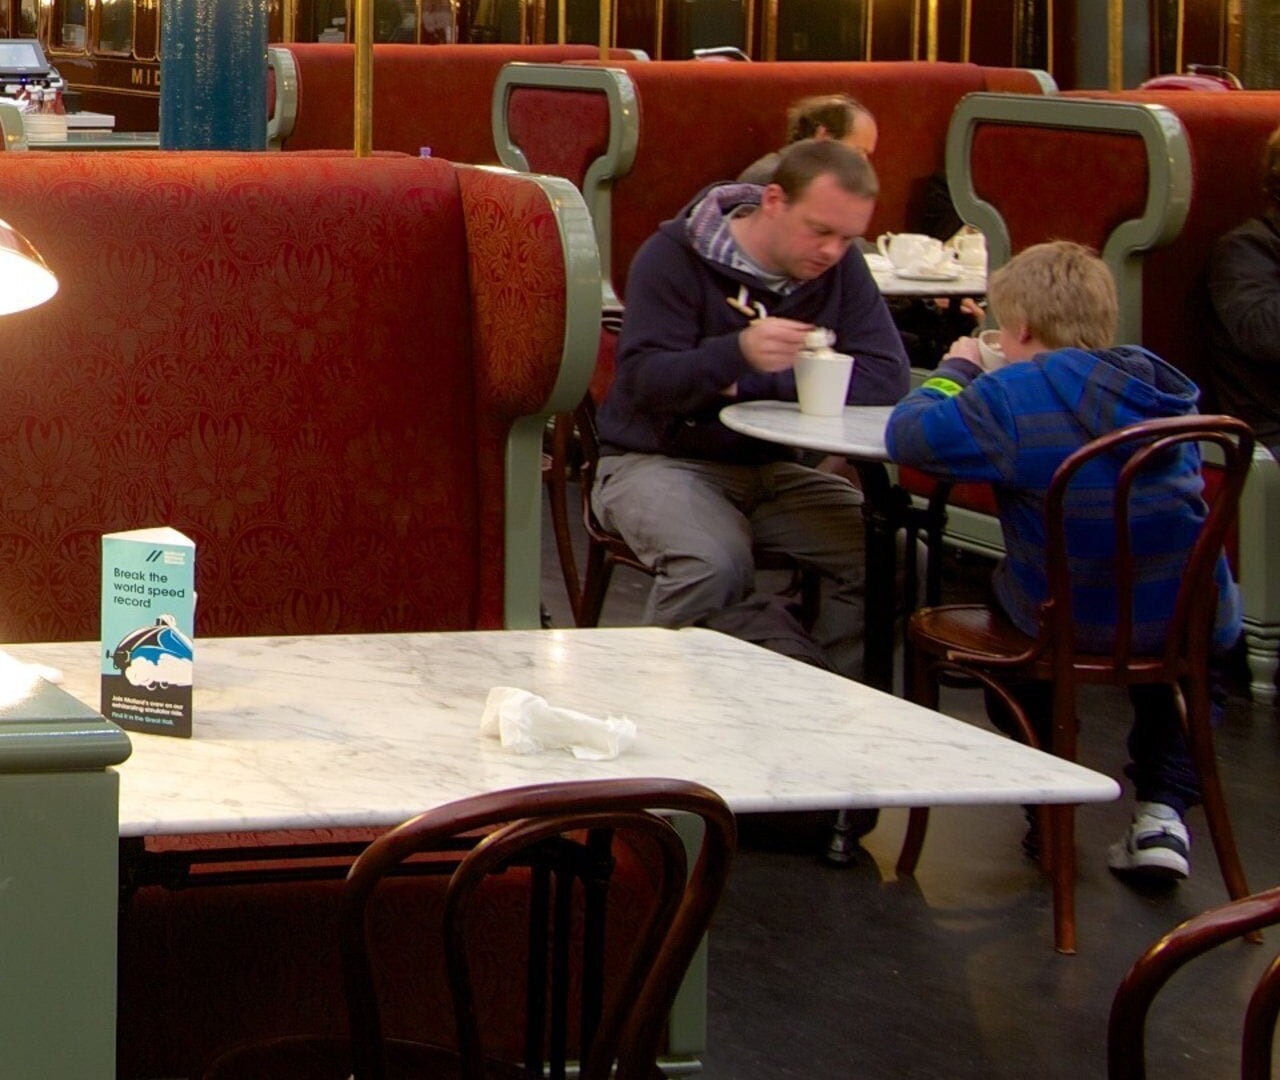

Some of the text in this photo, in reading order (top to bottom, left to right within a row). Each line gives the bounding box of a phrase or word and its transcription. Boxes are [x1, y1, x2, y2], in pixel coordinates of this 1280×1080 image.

[113, 567, 168, 583] Break the
[113, 582, 185, 598] world speed
[113, 595, 151, 608] record
